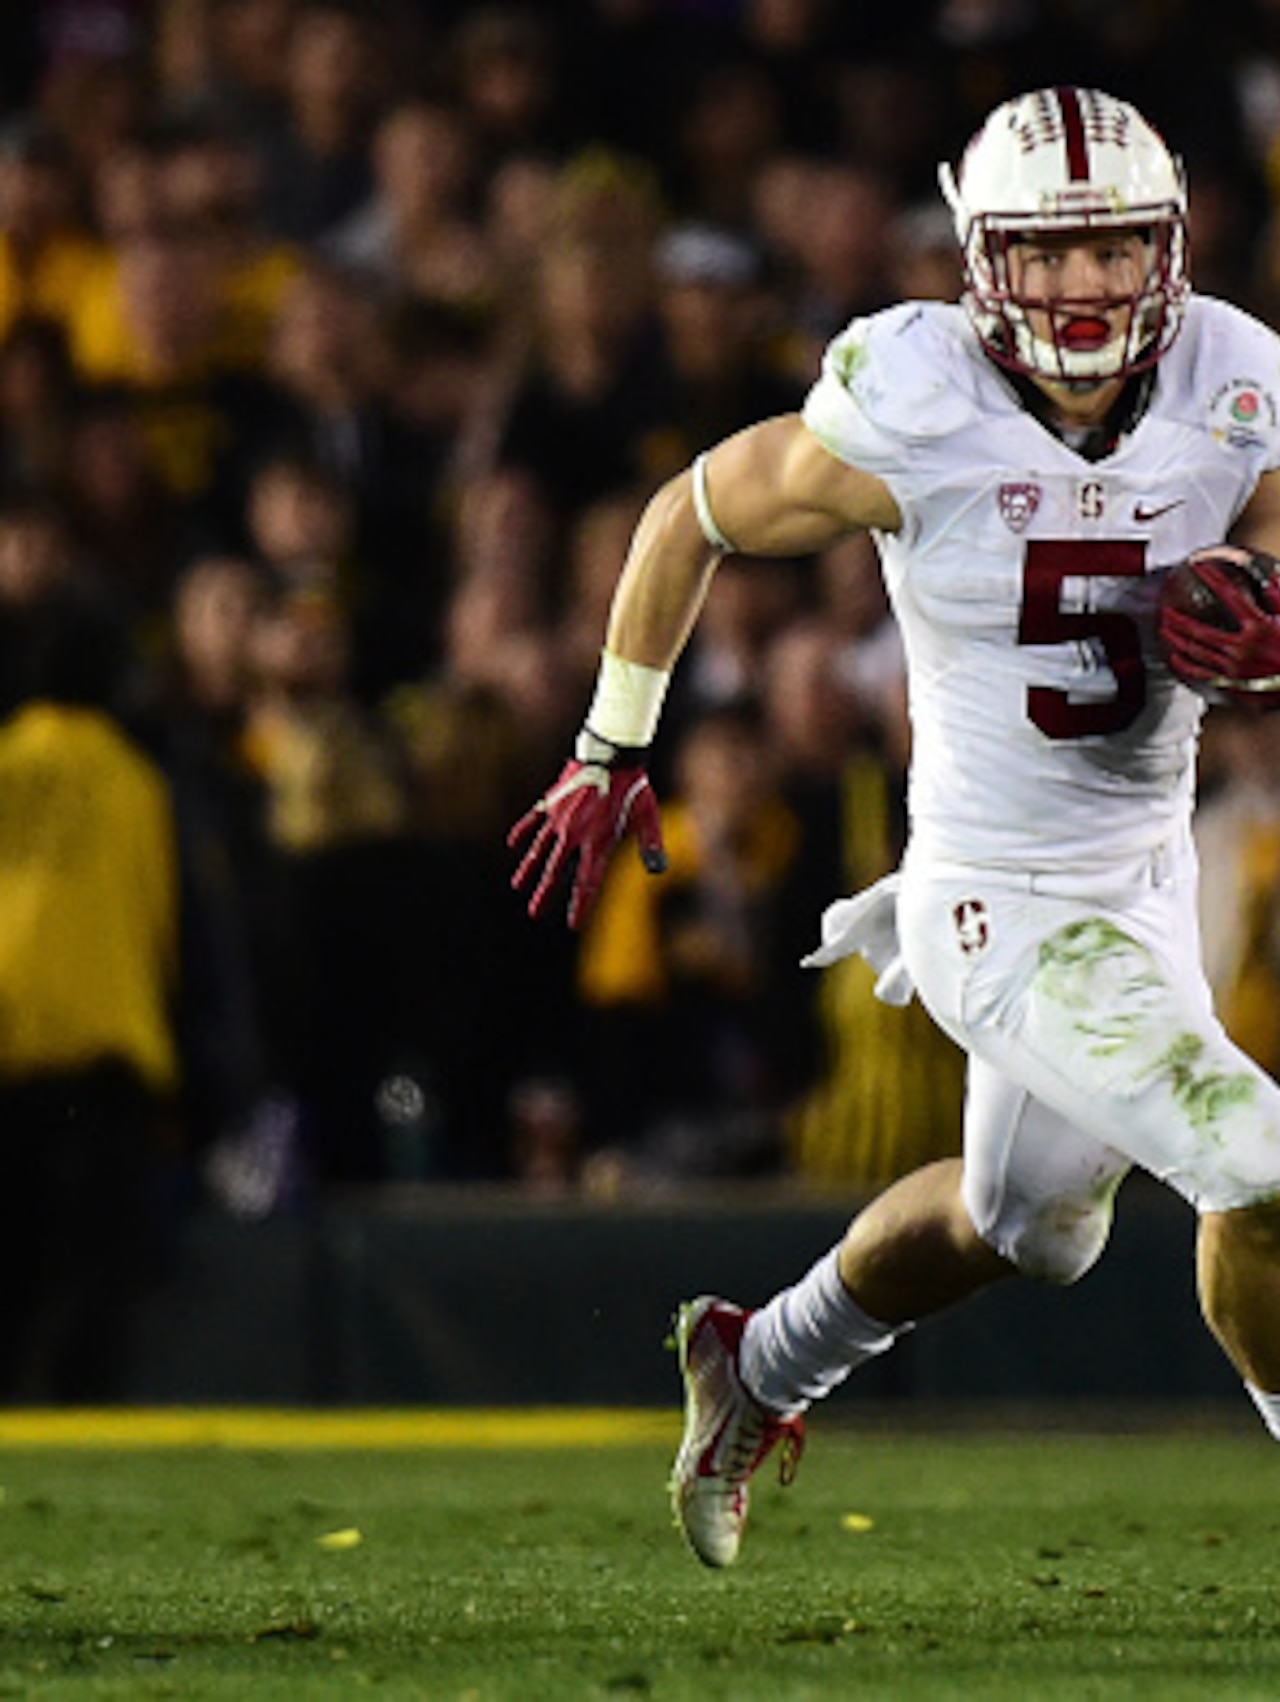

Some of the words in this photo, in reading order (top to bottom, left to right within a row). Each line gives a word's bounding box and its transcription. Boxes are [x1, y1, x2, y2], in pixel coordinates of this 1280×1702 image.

[1081, 482, 1104, 519] S
[1017, 539, 1150, 739] 5
[952, 899, 988, 954] S
